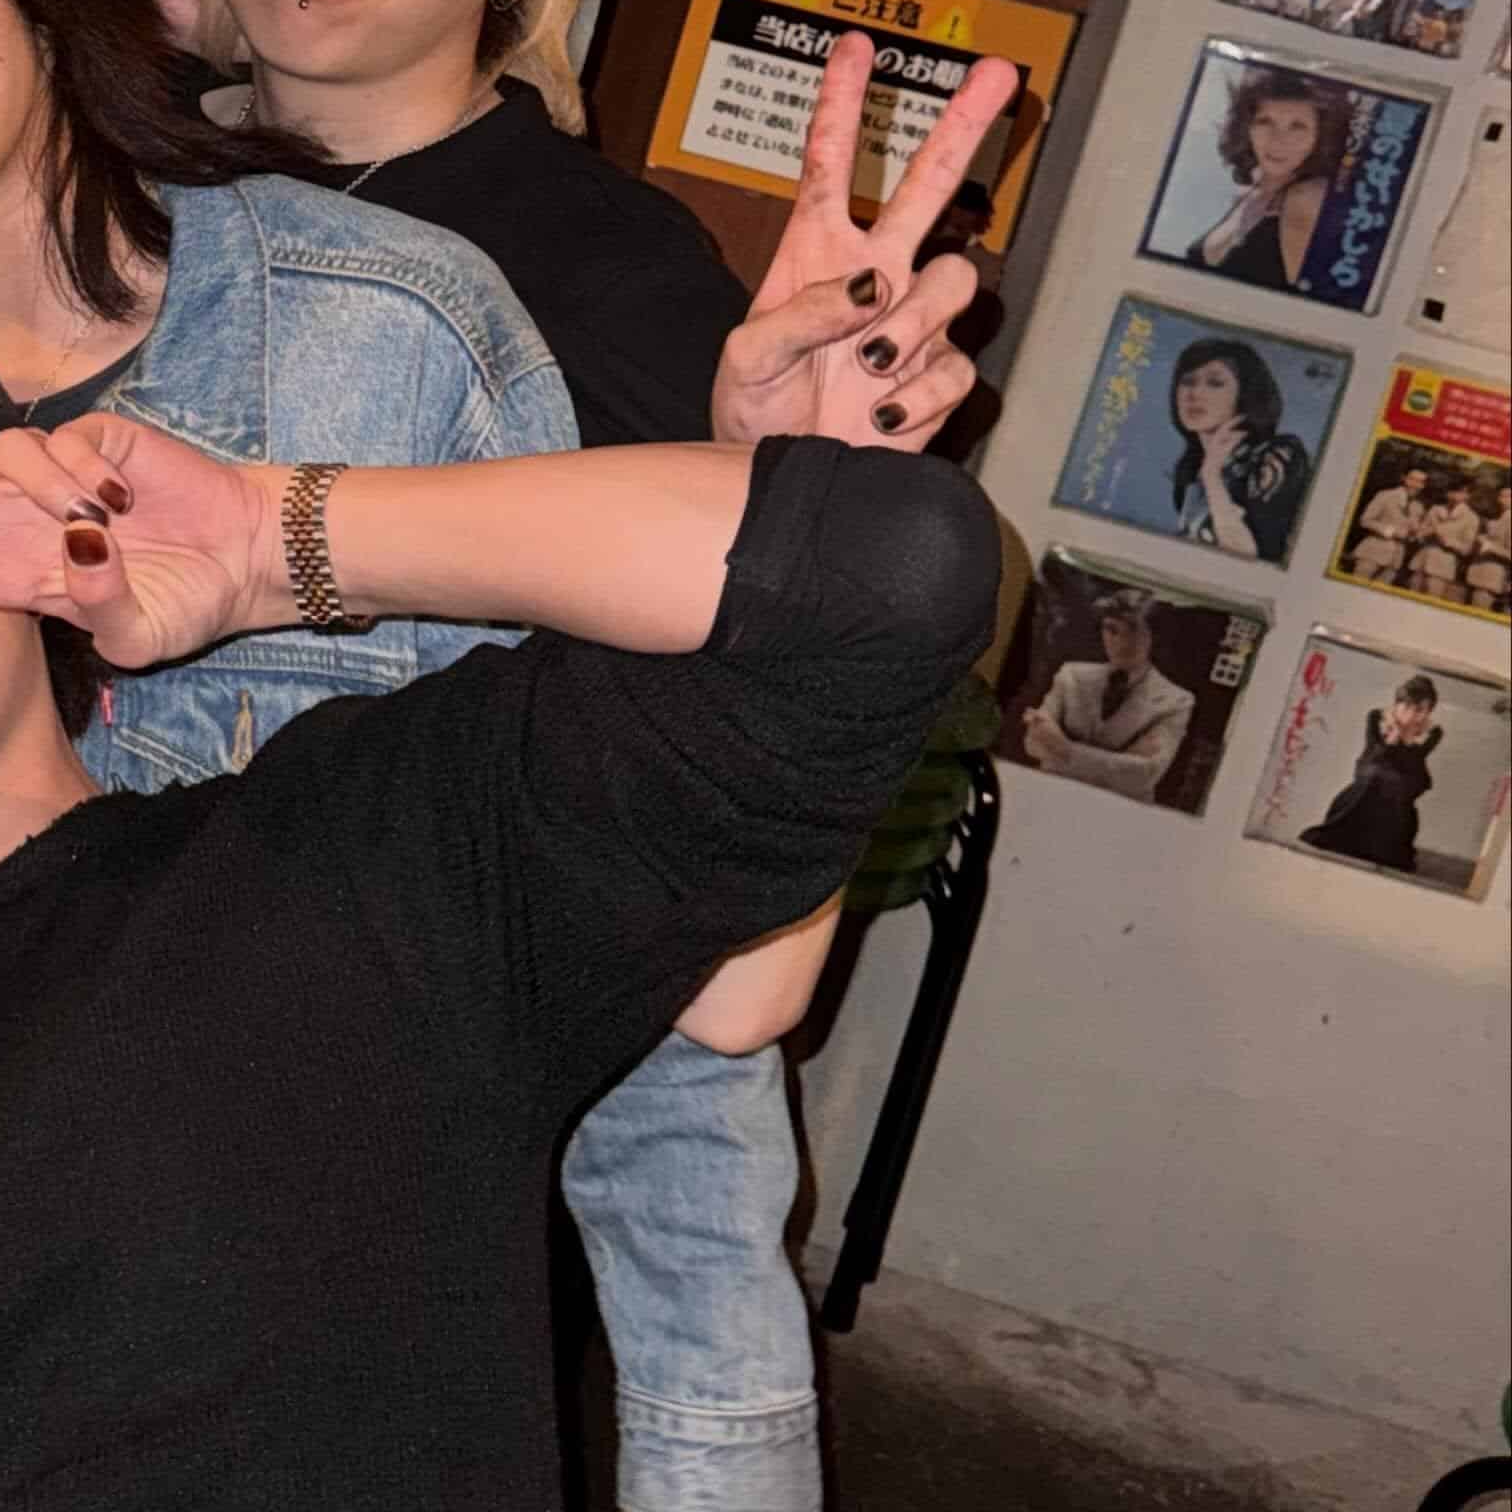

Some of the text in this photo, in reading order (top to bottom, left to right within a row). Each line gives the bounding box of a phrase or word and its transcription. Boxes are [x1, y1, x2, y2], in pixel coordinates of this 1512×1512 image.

[752, 15, 969, 91] 当店かのお願
